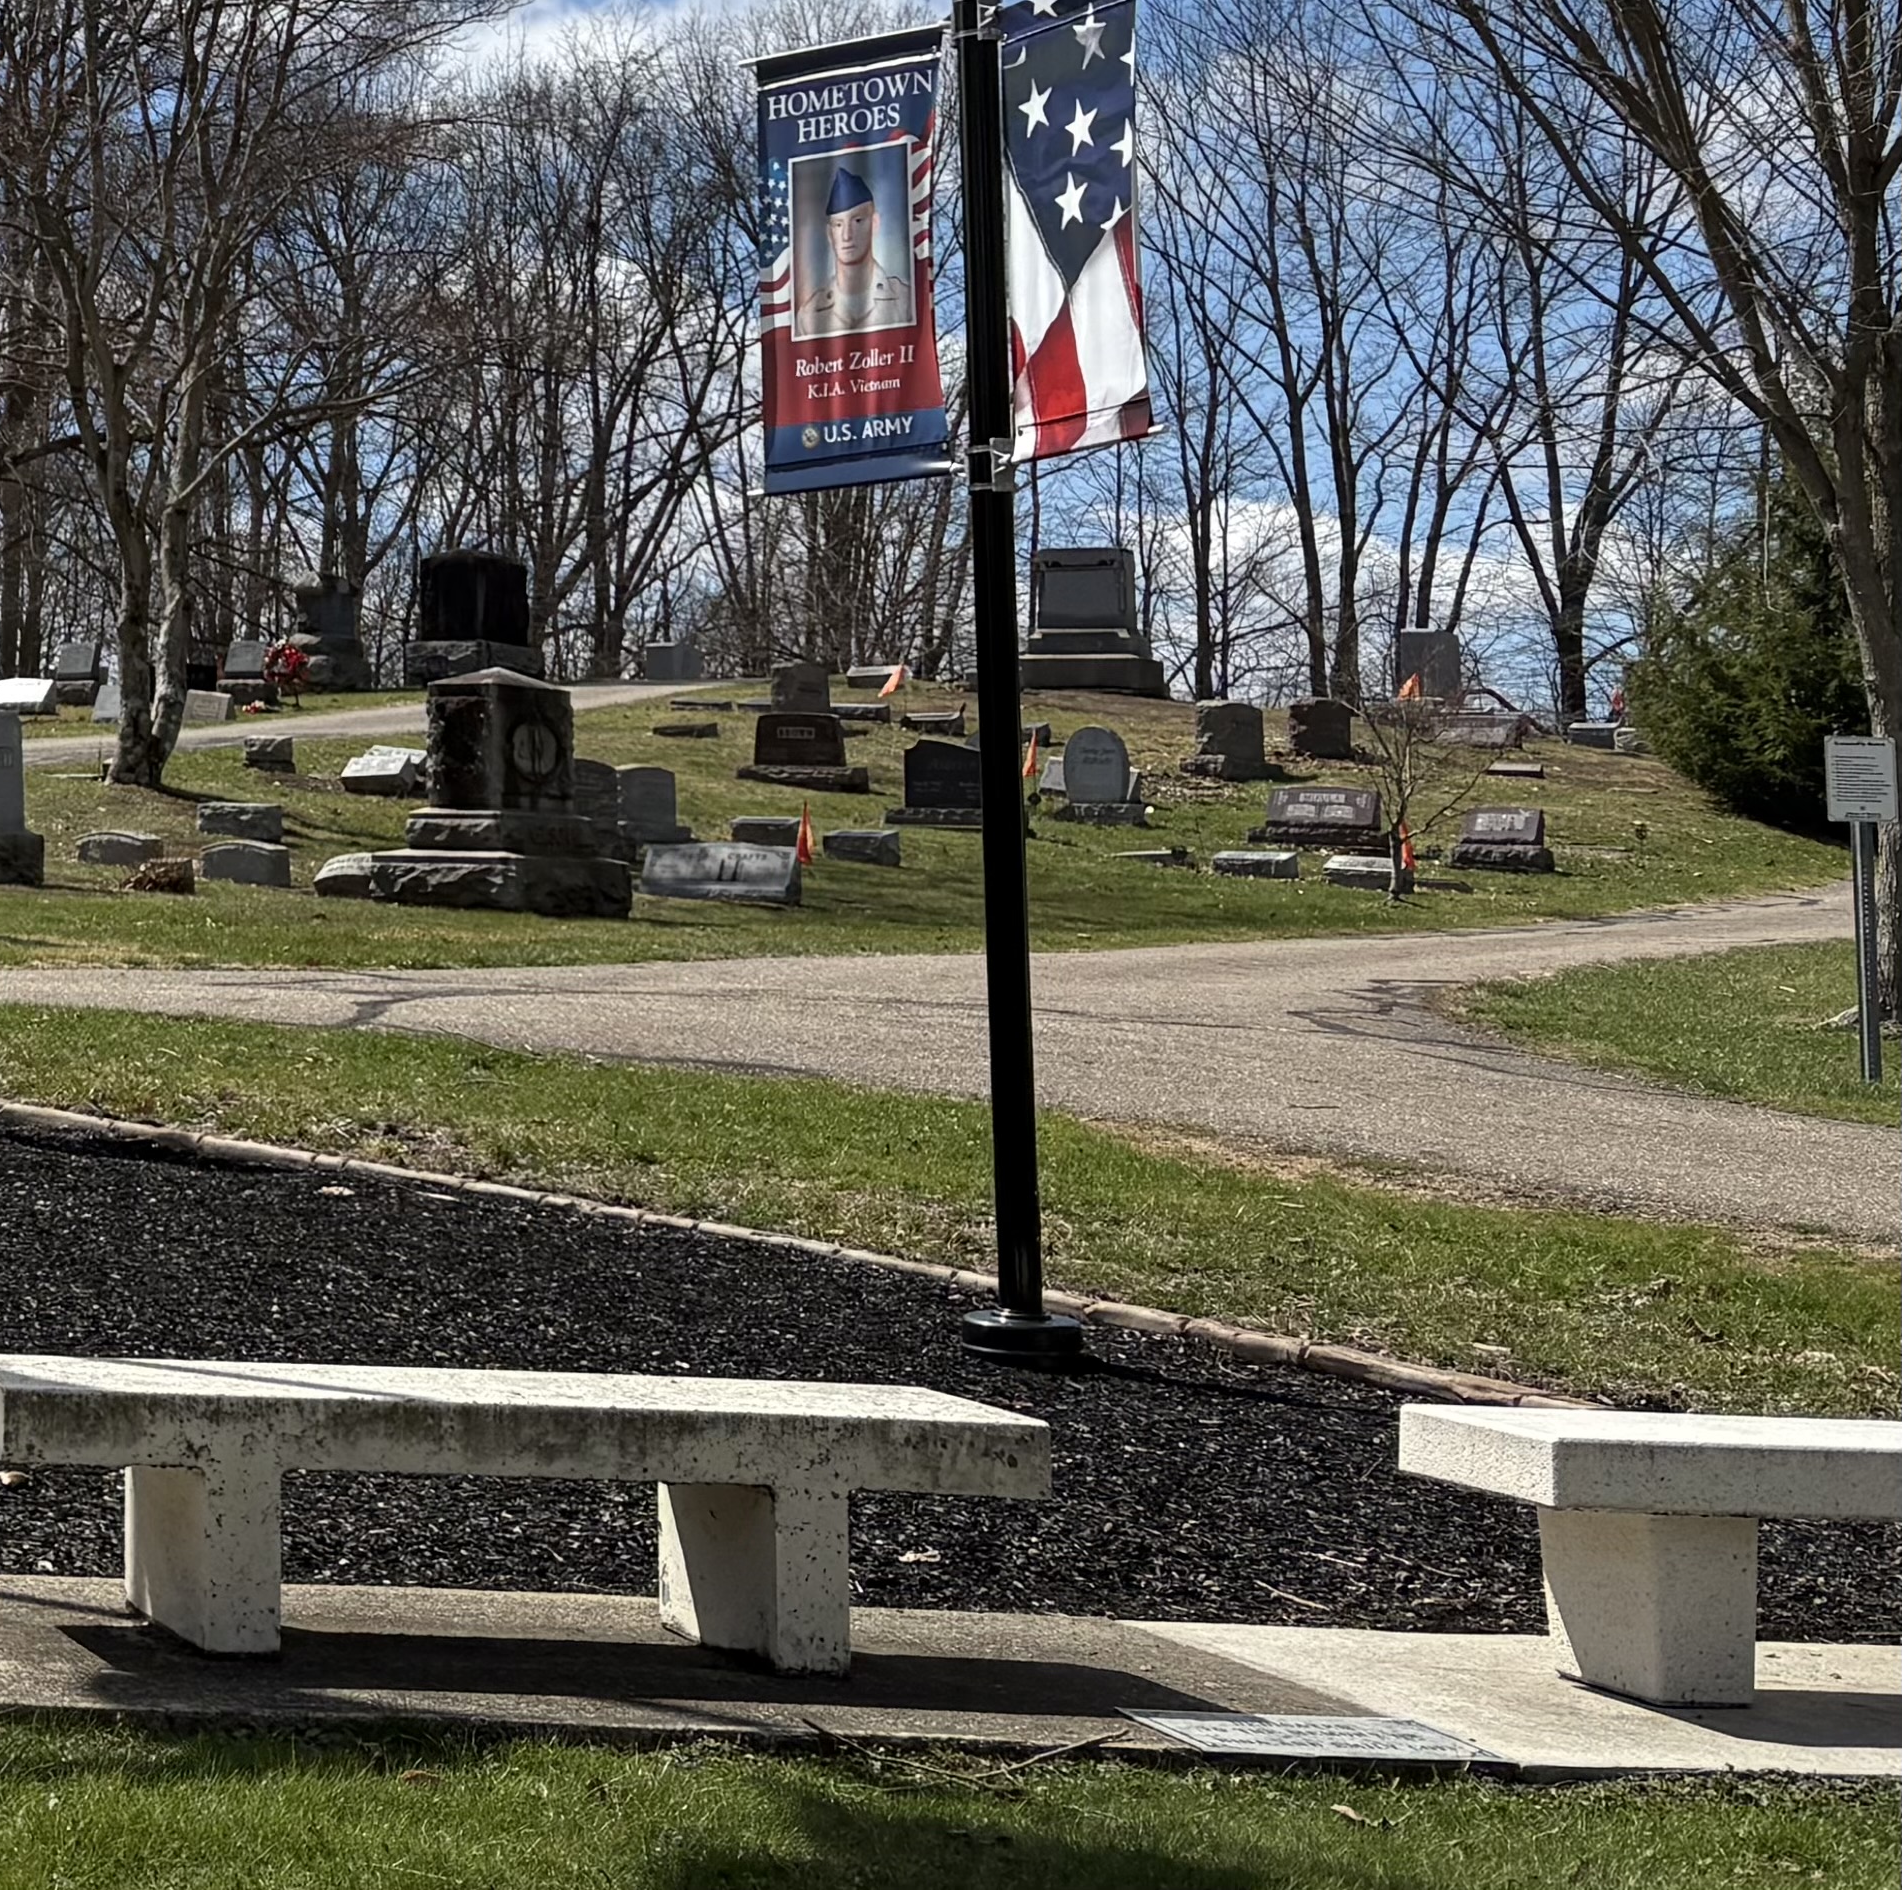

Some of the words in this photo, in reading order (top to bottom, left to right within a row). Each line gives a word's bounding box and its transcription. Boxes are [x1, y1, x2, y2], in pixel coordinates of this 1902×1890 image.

[767, 68, 934, 121] HOMETOWN
[797, 102, 901, 144] HEROES
[795, 350, 845, 377] Robert
[849, 347, 895, 372] Zoller
[899, 344, 915, 365] II
[807, 378, 846, 400] K.I.A.
[850, 374, 901, 395] Vietnam
[823, 422, 858, 442] U.S.
[862, 415, 914, 440] ARMY
